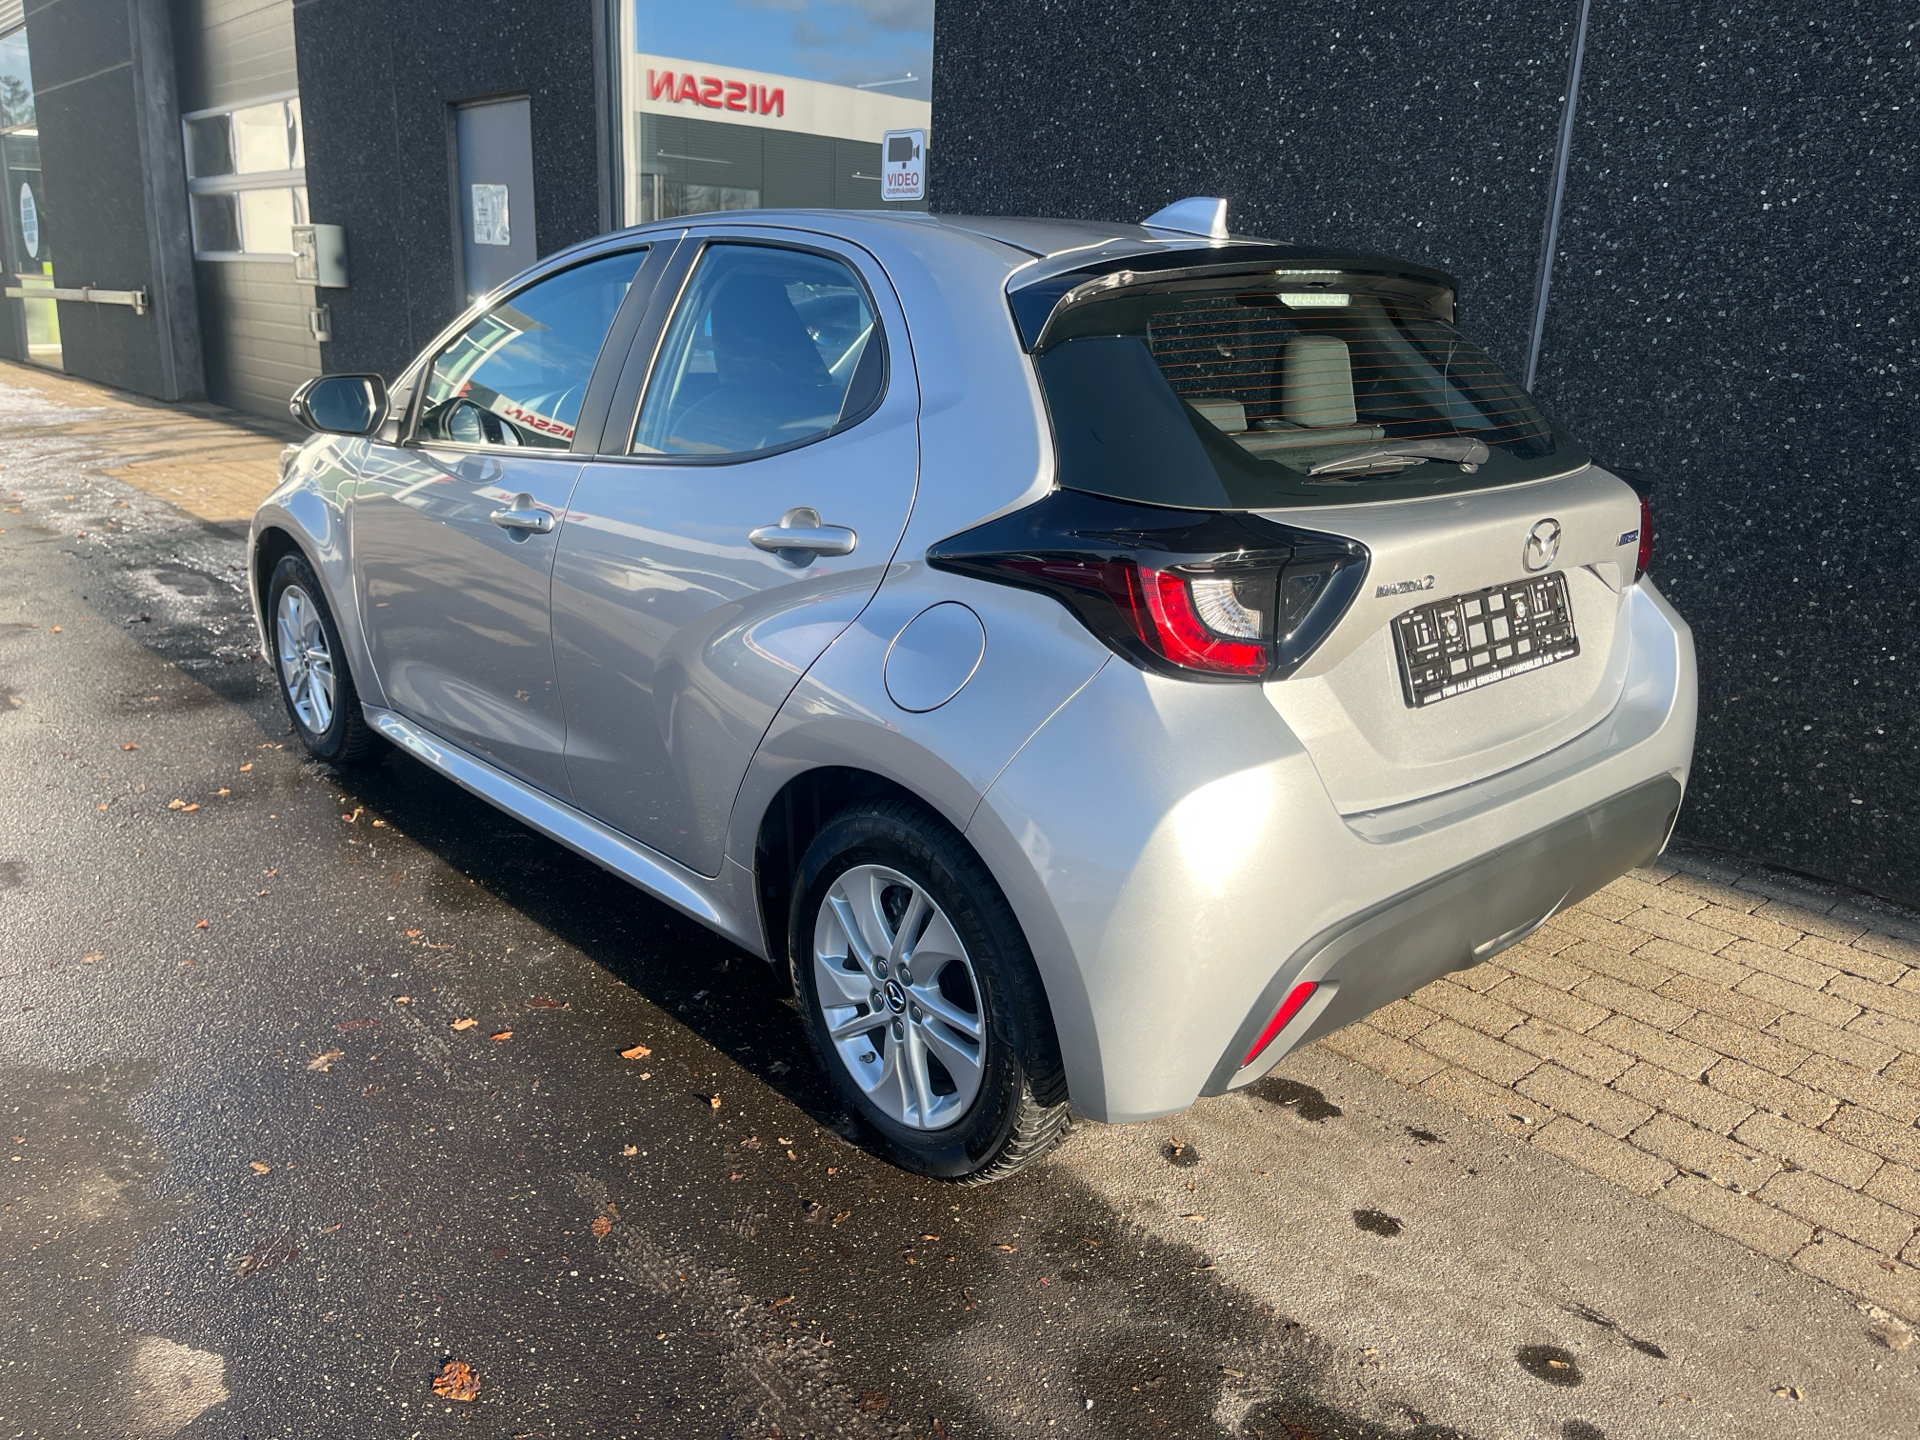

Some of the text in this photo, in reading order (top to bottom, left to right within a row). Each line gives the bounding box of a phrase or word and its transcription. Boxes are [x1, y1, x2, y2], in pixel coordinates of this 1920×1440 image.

[887, 172, 919, 187] VIDEO
[1457, 678, 1476, 693] ALLAN
[1476, 669, 1502, 687] ERIKSEN
[1502, 657, 1543, 678] AUTOMOBILER
[1543, 653, 1554, 665] A/S
